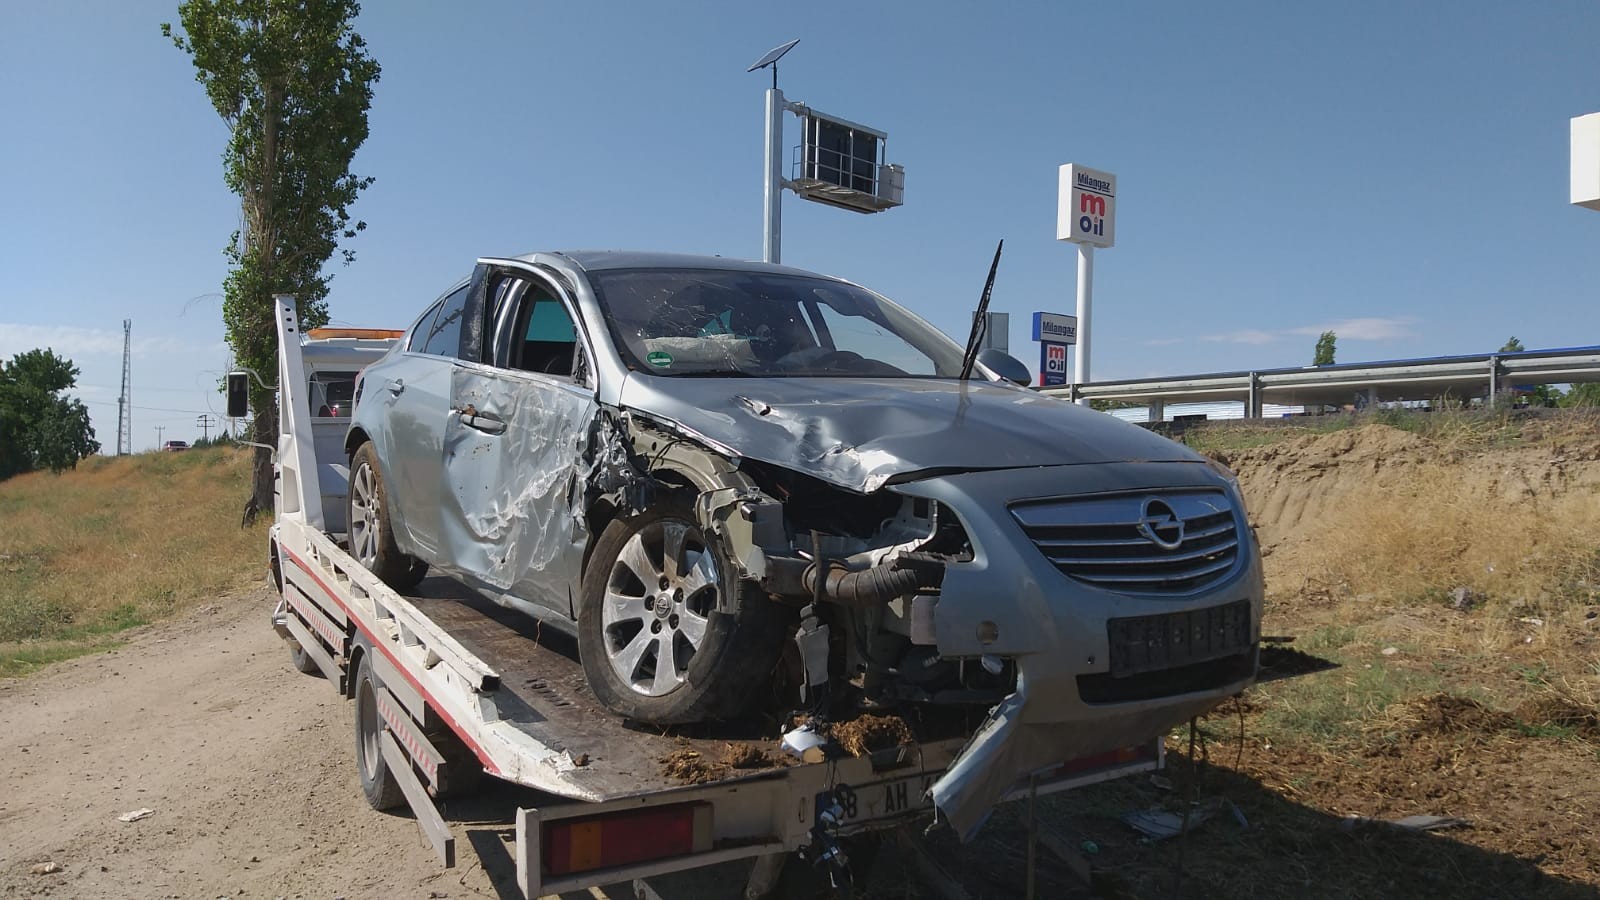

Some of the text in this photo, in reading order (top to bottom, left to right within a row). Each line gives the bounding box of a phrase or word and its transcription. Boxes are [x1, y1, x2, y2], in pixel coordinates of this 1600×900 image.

[1078, 172, 1111, 191] Milangaz
[1042, 320, 1076, 337] Milangaz
[885, 782, 909, 813] AH
